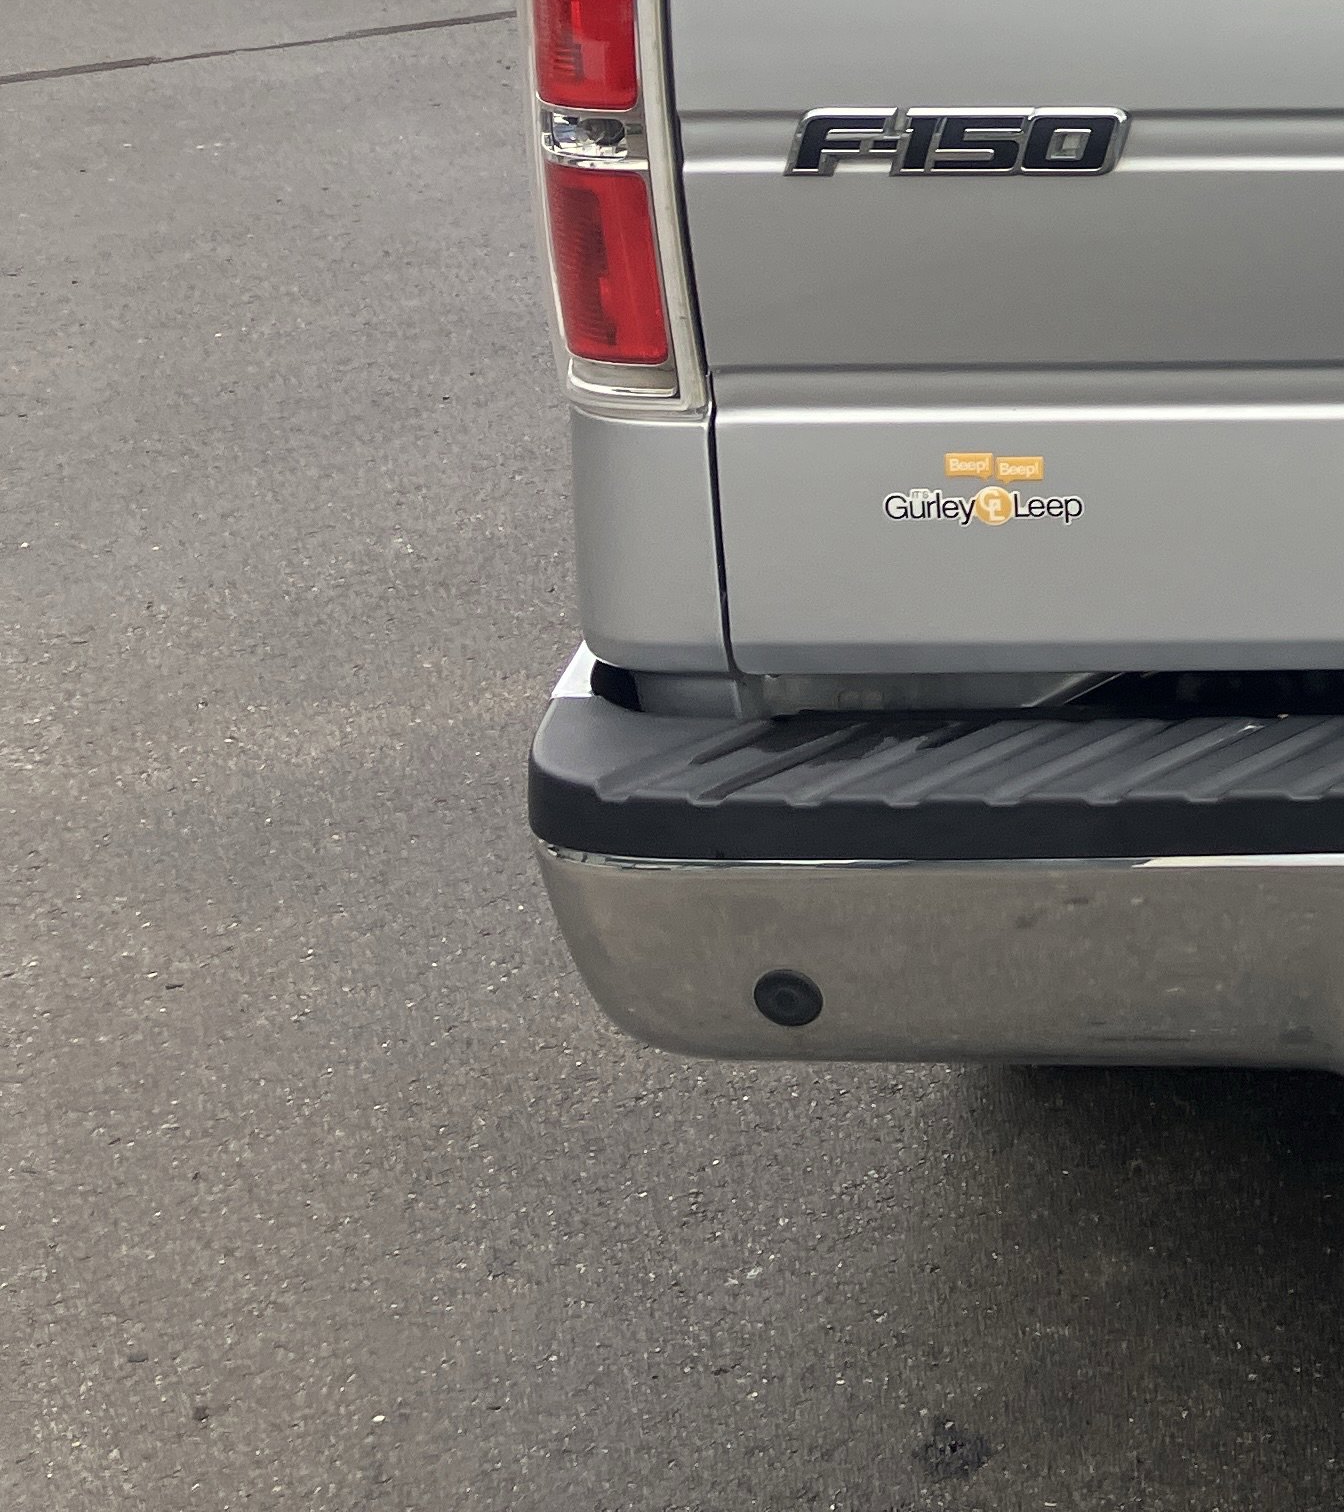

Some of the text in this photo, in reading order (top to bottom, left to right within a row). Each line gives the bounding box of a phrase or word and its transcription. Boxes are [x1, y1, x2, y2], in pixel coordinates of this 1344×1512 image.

[784, 106, 1130, 177] F-150
[949, 458, 1039, 477] Beep! Beep!
[885, 493, 976, 525] Gurley
[1014, 493, 1083, 524] Leep
